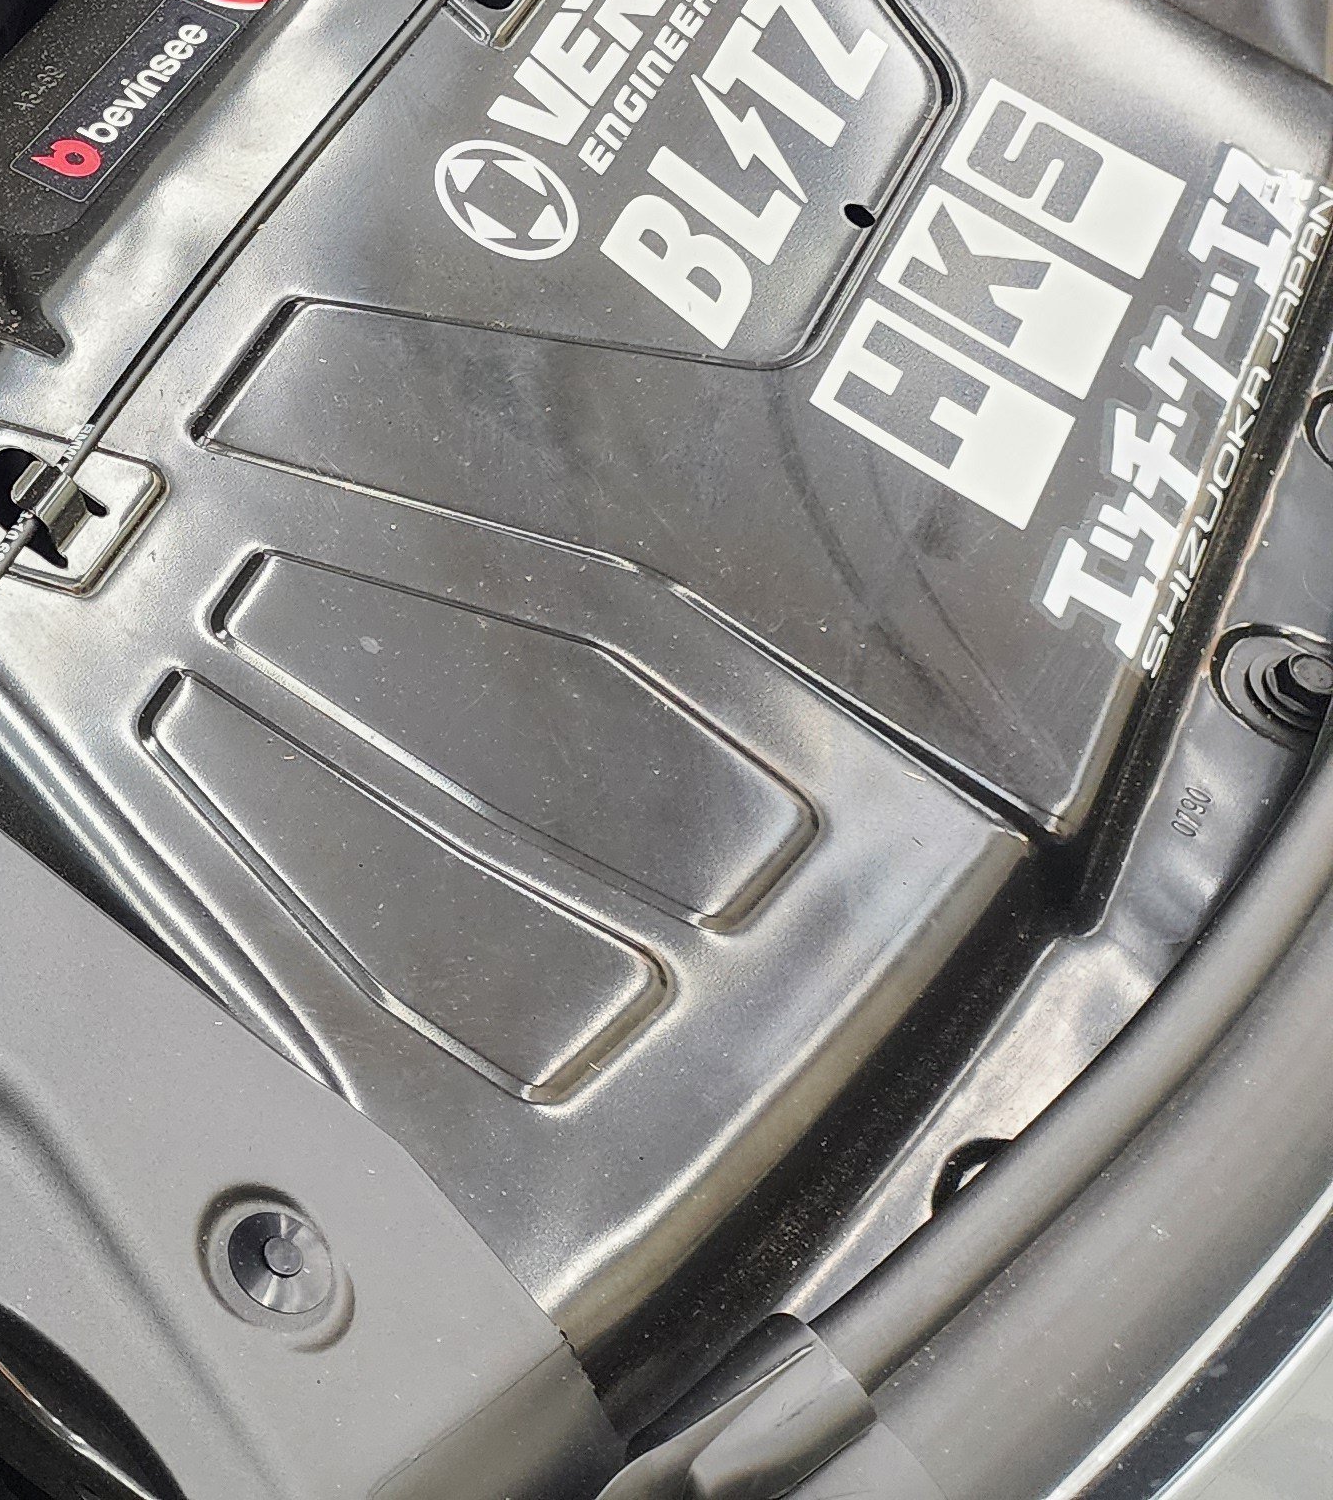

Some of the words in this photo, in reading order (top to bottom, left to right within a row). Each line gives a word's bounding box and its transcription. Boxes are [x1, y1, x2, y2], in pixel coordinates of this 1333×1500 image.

[77, 22, 208, 144] bevinsee
[818, 85, 1148, 495] HKS
[1141, 364, 1272, 678] SHIZUOKA
[1271, 185, 1333, 362] JAPAN
